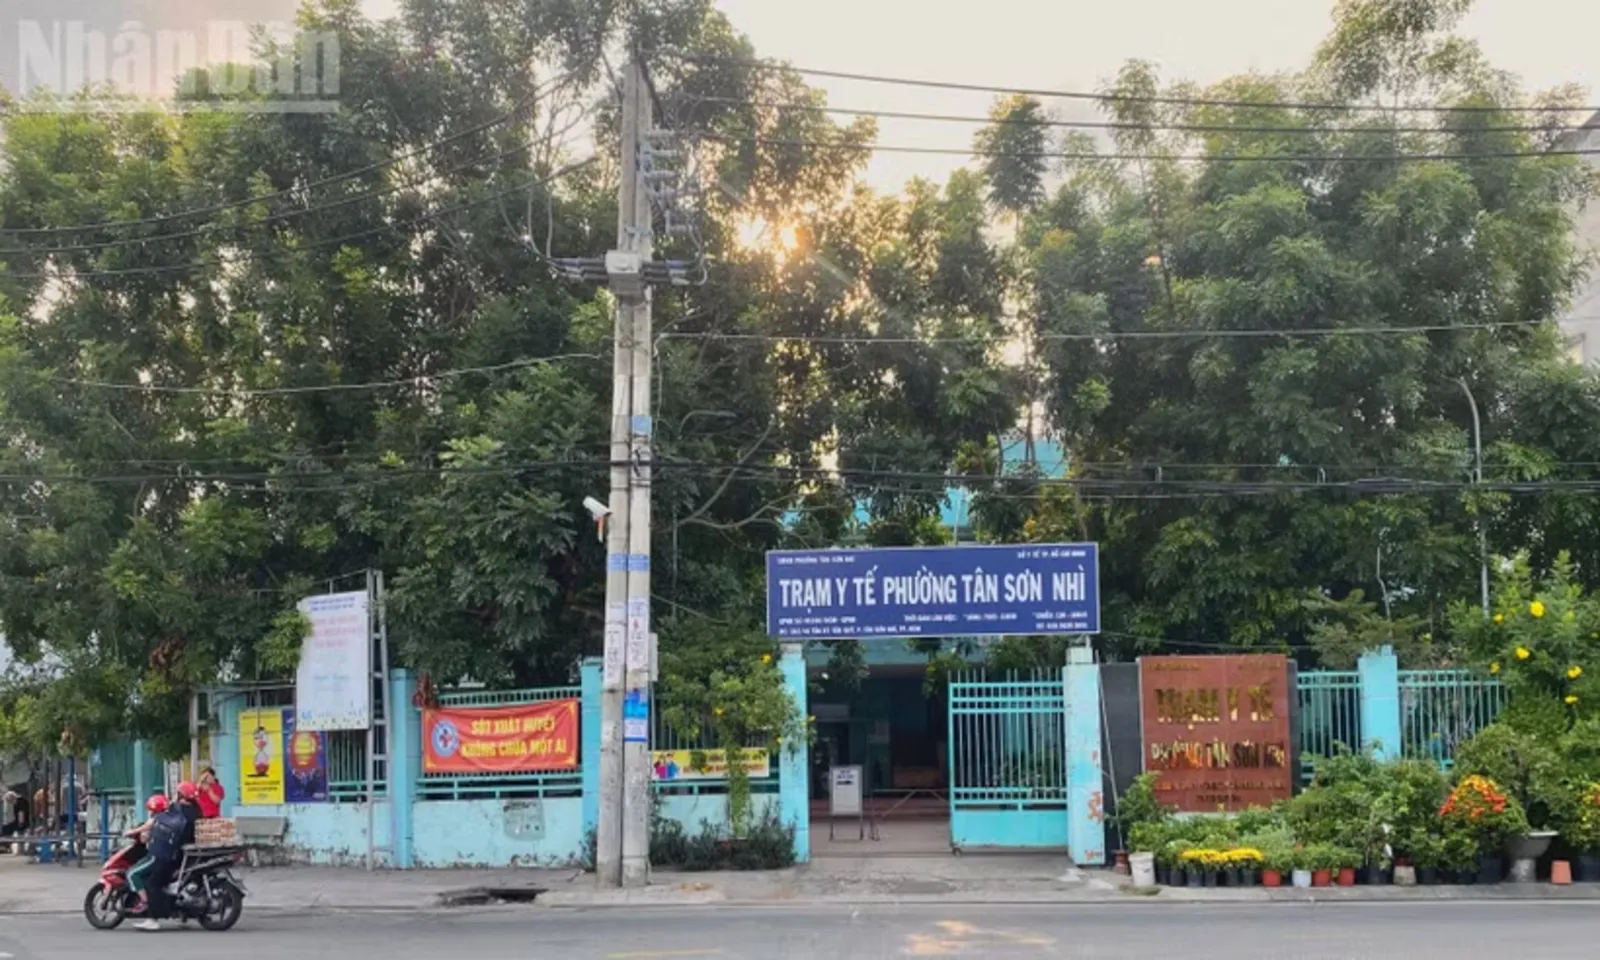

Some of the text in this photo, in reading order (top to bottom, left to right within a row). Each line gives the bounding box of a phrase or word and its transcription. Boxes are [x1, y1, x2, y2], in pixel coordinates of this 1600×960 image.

[779, 564, 1086, 614] TRẠM Y TẾ PHƯỜNG TÂN SƠN NHÌ
[1155, 689, 1220, 730] TRẠM
[1227, 687, 1240, 722] Y
[494, 716, 520, 734] XUẤT
[555, 739, 566, 753] AI
